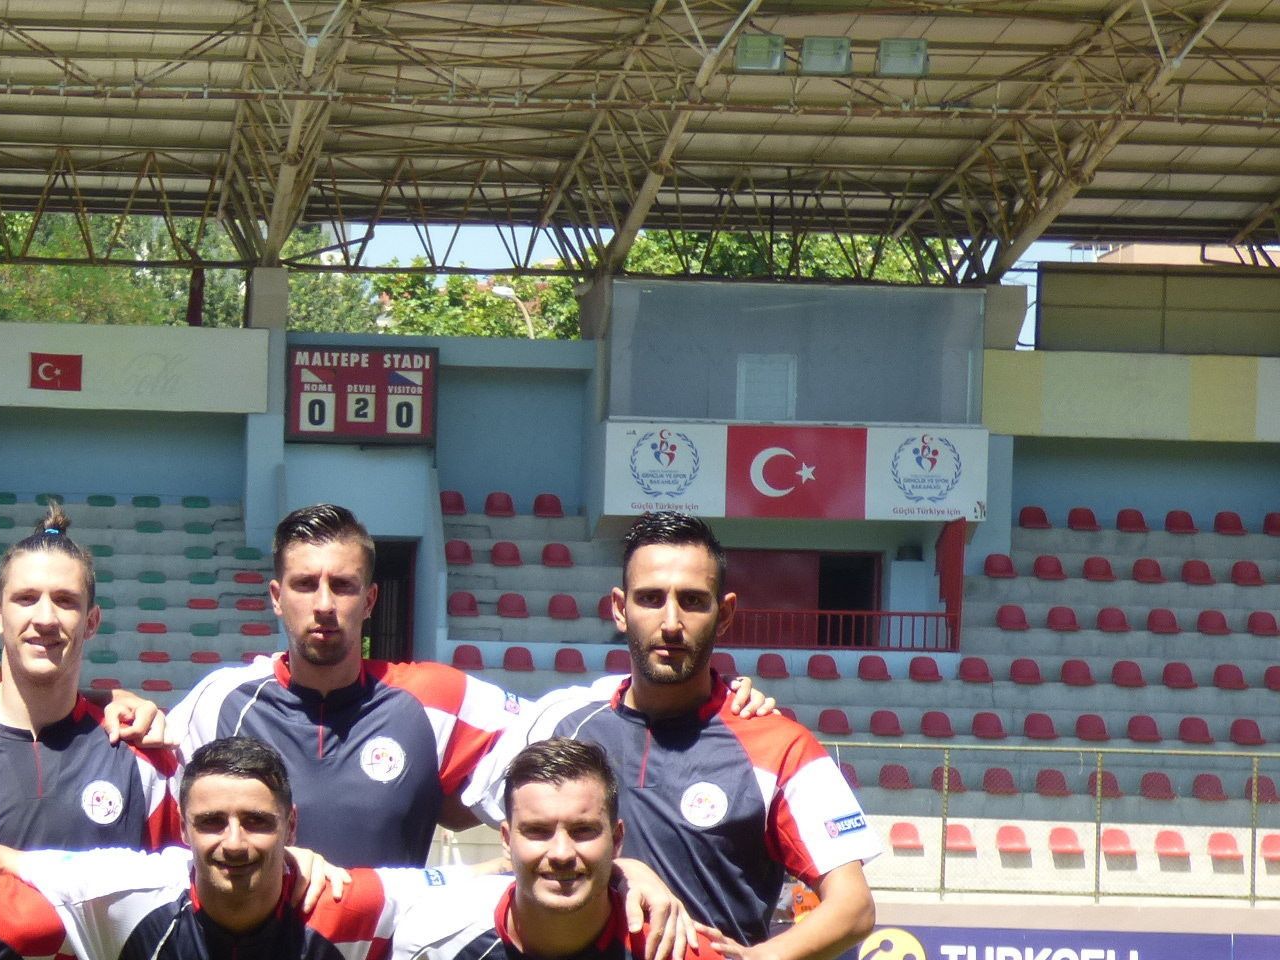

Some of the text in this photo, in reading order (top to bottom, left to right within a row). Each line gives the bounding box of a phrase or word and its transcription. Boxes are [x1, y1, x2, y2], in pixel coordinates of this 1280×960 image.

[295, 351, 431, 370] MALTEPE STADI
[303, 383, 334, 393] HOME
[346, 384, 377, 394] DEVRE
[387, 385, 424, 395] VISITOR
[307, 398, 327, 427] 0
[353, 397, 370, 420] 2
[395, 400, 414, 429] 0
[655, 502, 683, 511] Türkiye
[916, 506, 946, 516] Türkiye
